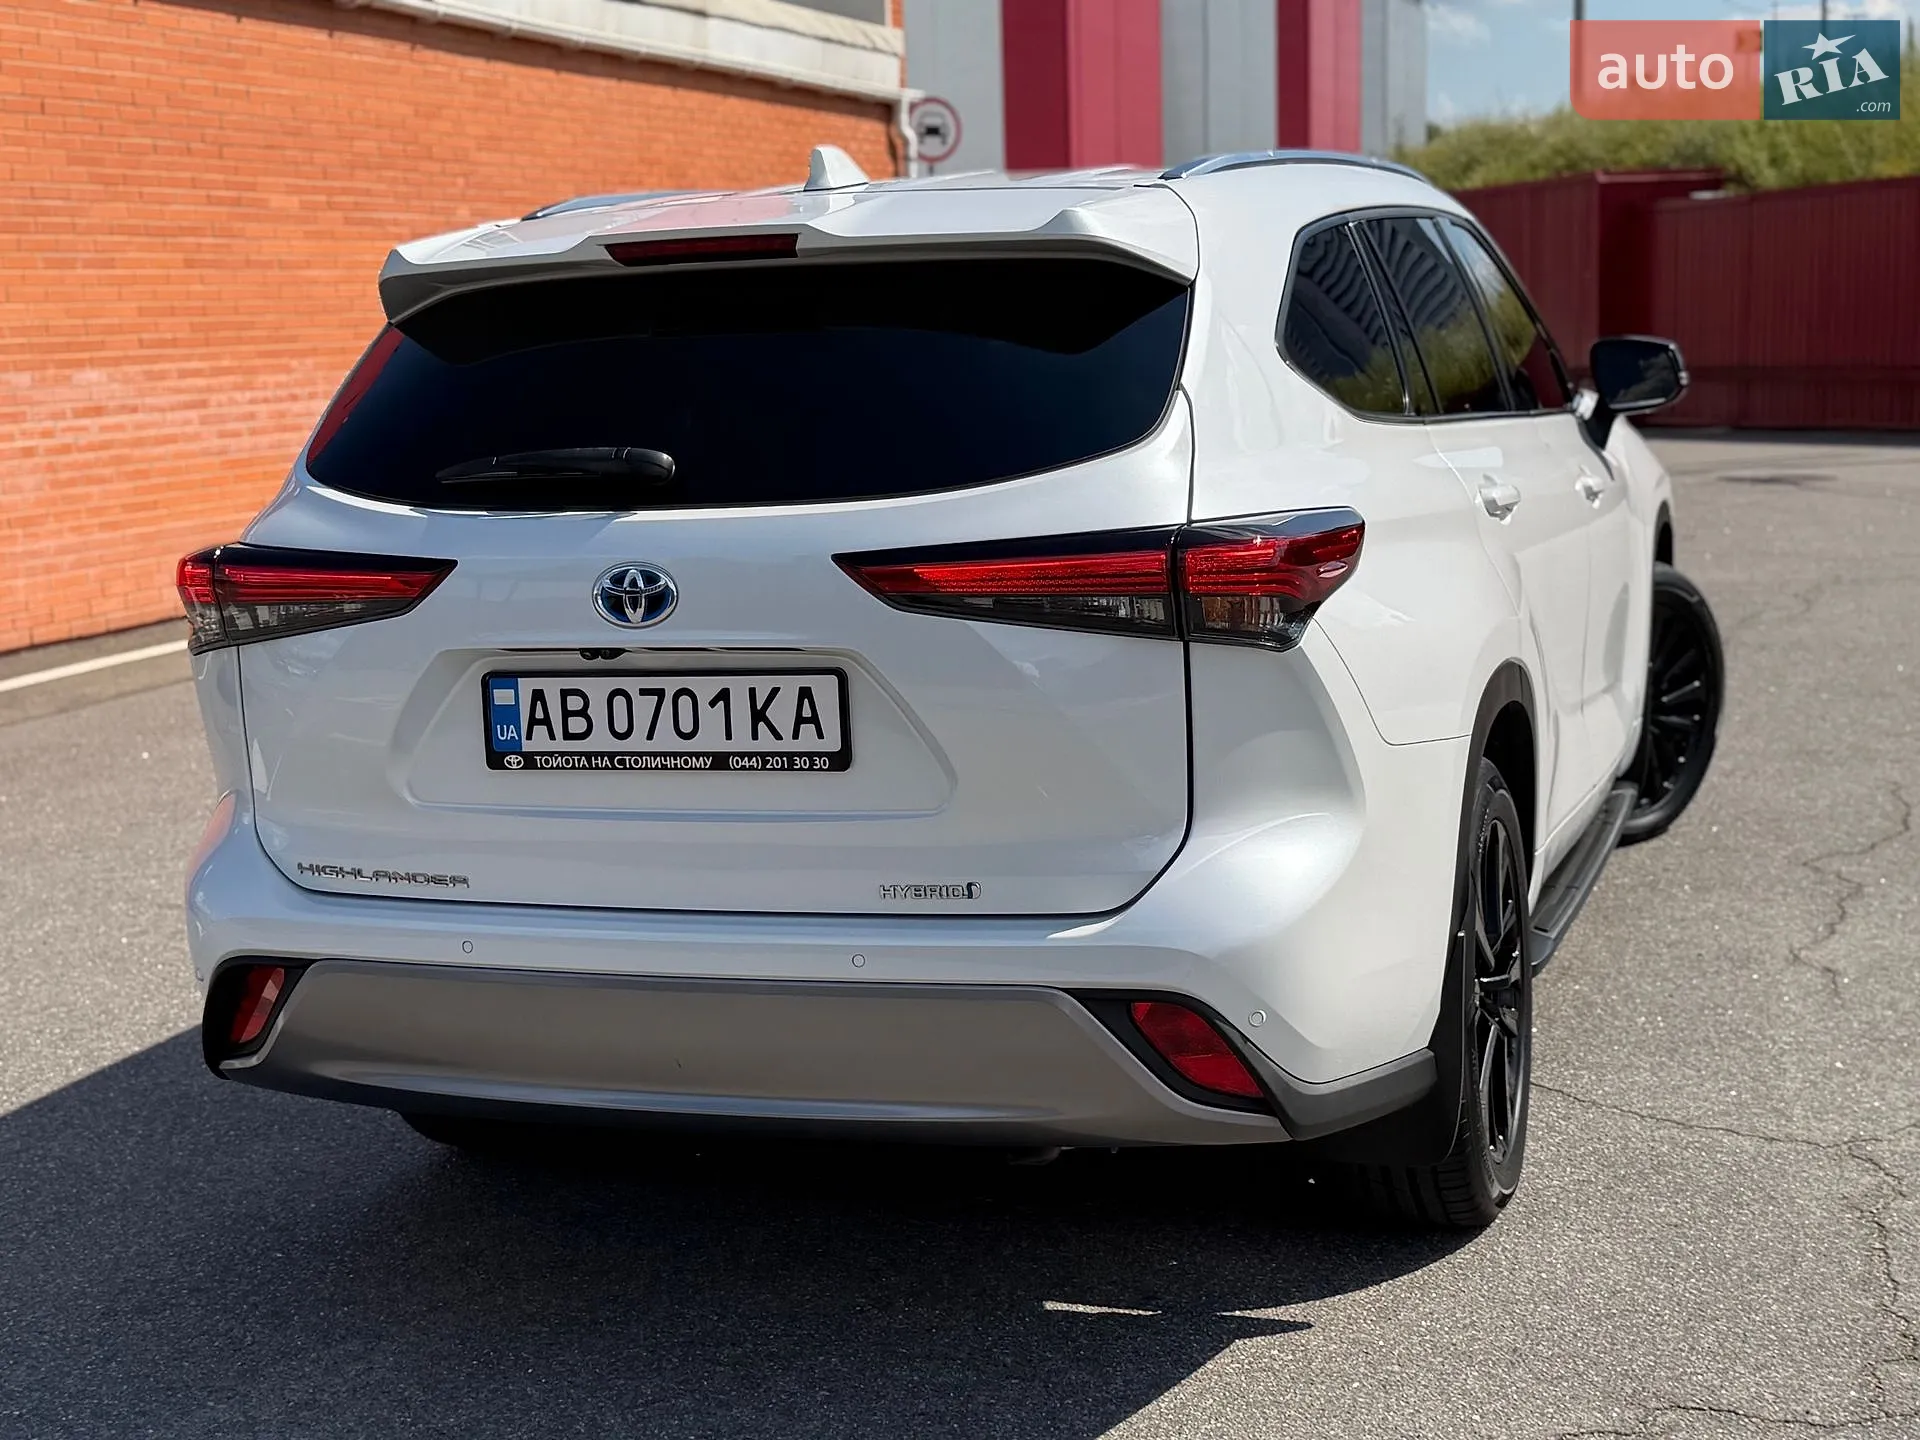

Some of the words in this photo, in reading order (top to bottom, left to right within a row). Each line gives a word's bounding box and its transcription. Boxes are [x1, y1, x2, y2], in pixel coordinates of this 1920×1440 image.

[524, 687, 595, 742] AB
[605, 687, 732, 742] 0701
[747, 685, 826, 741] KA
[496, 724, 519, 741] UA
[534, 754, 589, 769] ТОЙОТА
[591, 755, 612, 769] НА
[614, 755, 713, 770] СТОЛИЧНОМУ
[728, 755, 762, 771] (044)
[765, 756, 788, 770] 201
[793, 756, 809, 770] 30
[812, 756, 829, 770] 30
[297, 862, 470, 888] HIGHLANDER
[879, 884, 967, 900] HYBRID
